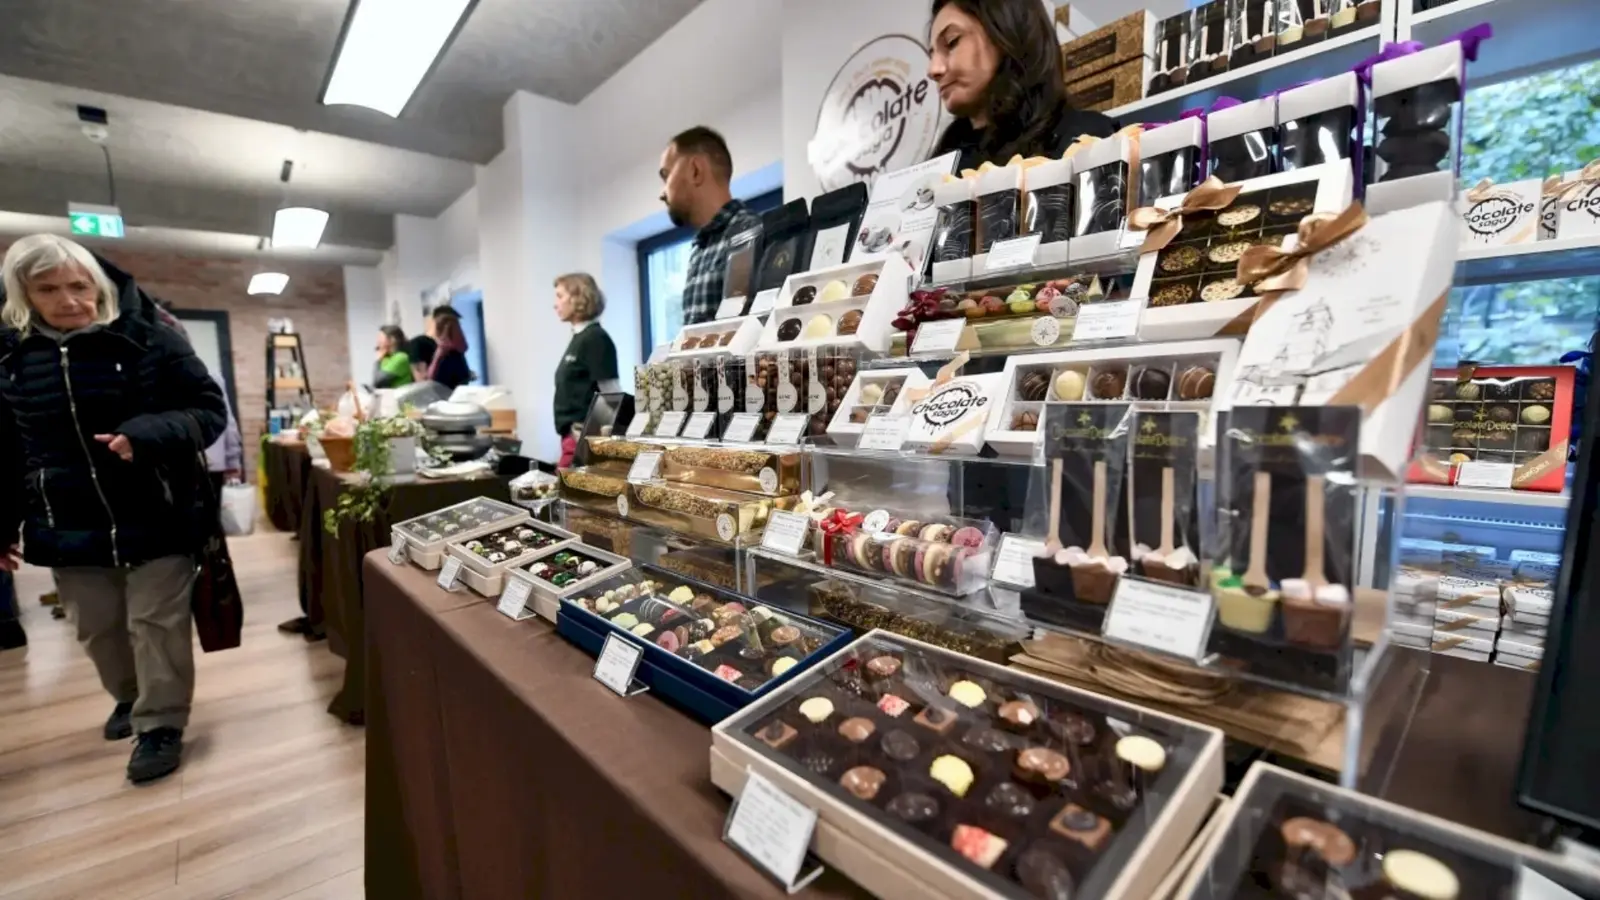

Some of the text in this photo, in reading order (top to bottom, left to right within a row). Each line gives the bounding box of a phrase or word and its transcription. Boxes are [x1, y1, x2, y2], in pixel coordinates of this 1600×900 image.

[1478, 217, 1507, 227] saga
[912, 396, 988, 415] Chocolate
[931, 408, 959, 418] saga
